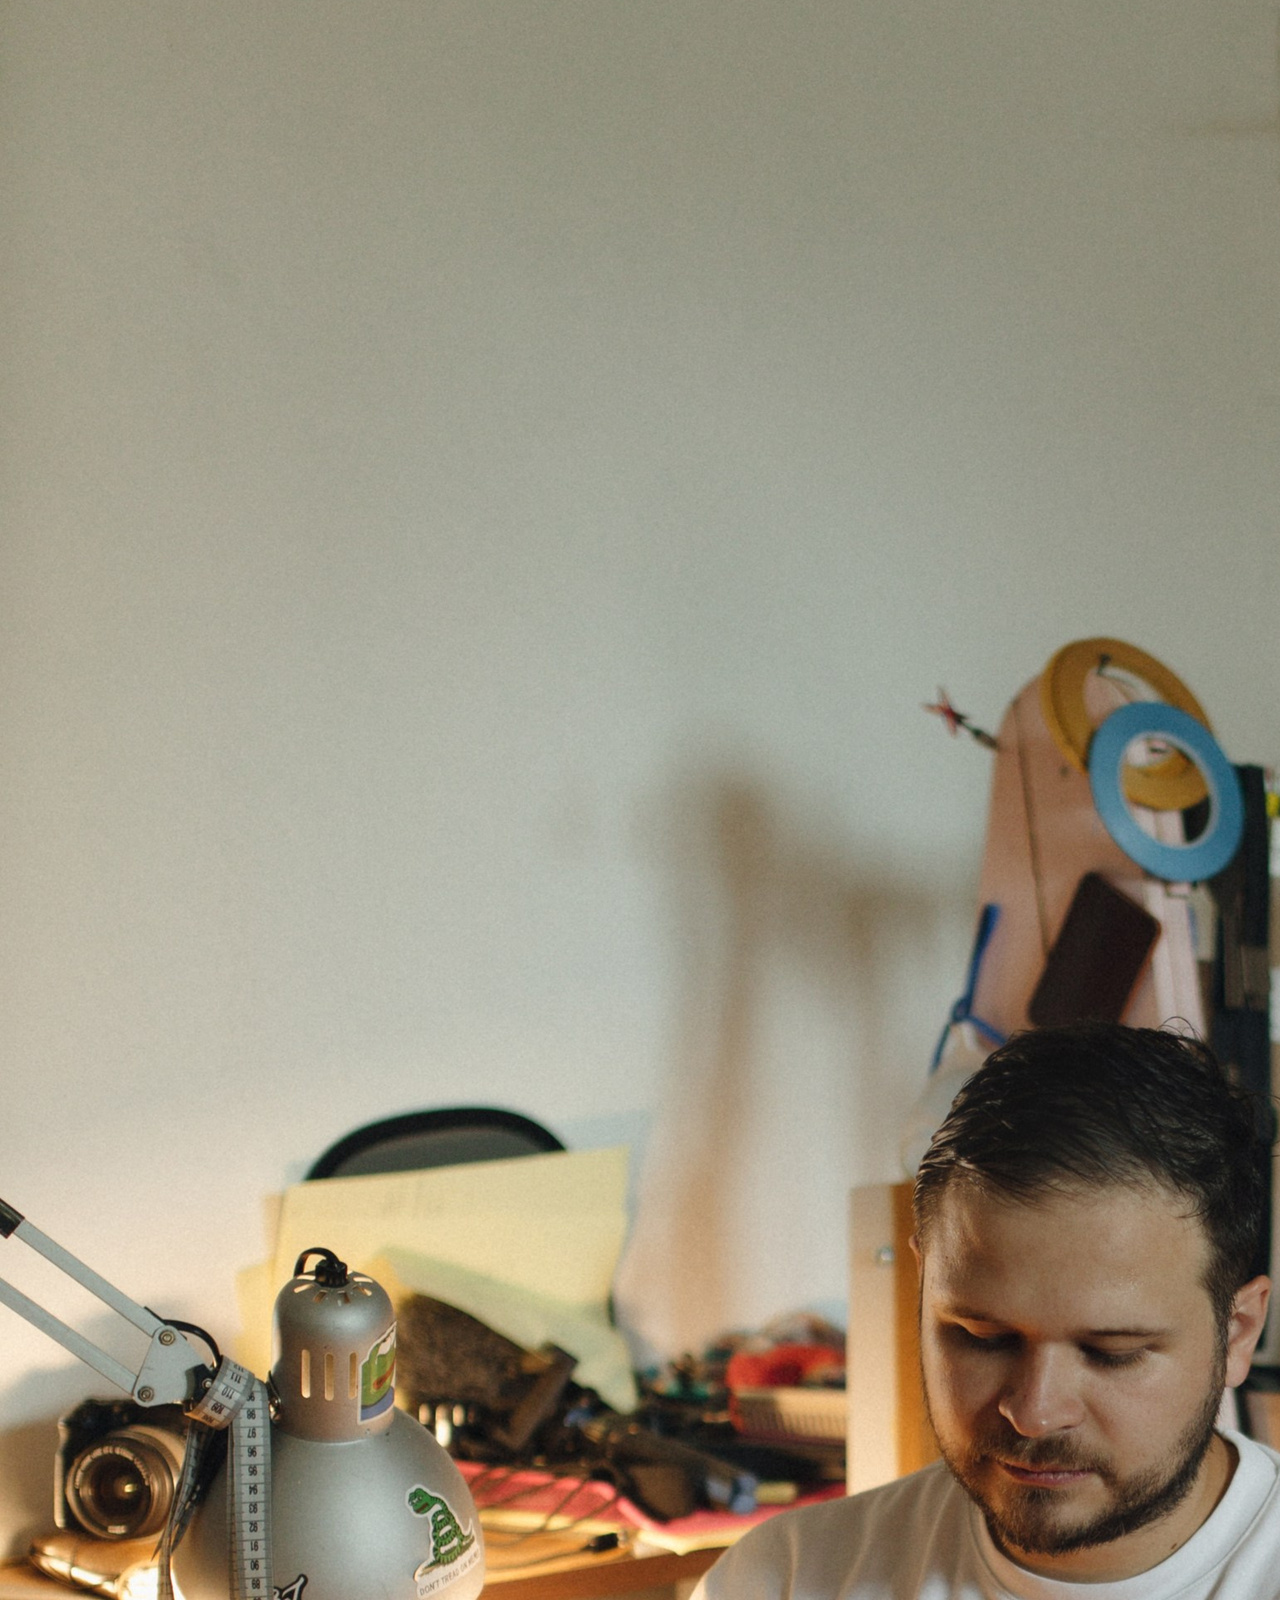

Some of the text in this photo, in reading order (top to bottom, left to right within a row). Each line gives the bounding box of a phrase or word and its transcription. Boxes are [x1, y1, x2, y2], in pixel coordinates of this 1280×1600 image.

[230, 1371, 242, 1384] 111
[221, 1385, 234, 1400] 110
[247, 1428, 256, 1438] 97
[248, 1447, 257, 1457] 96
[248, 1466, 257, 1476] 95
[249, 1484, 258, 1495] 94
[249, 1503, 258, 1514] 93
[249, 1522, 258, 1532] 92
[250, 1541, 259, 1551] 91
[250, 1560, 259, 1570] 90
[251, 1579, 260, 1589] 89
[420, 1580, 439, 1596] DON'T
[441, 1568, 459, 1585] TREAD
